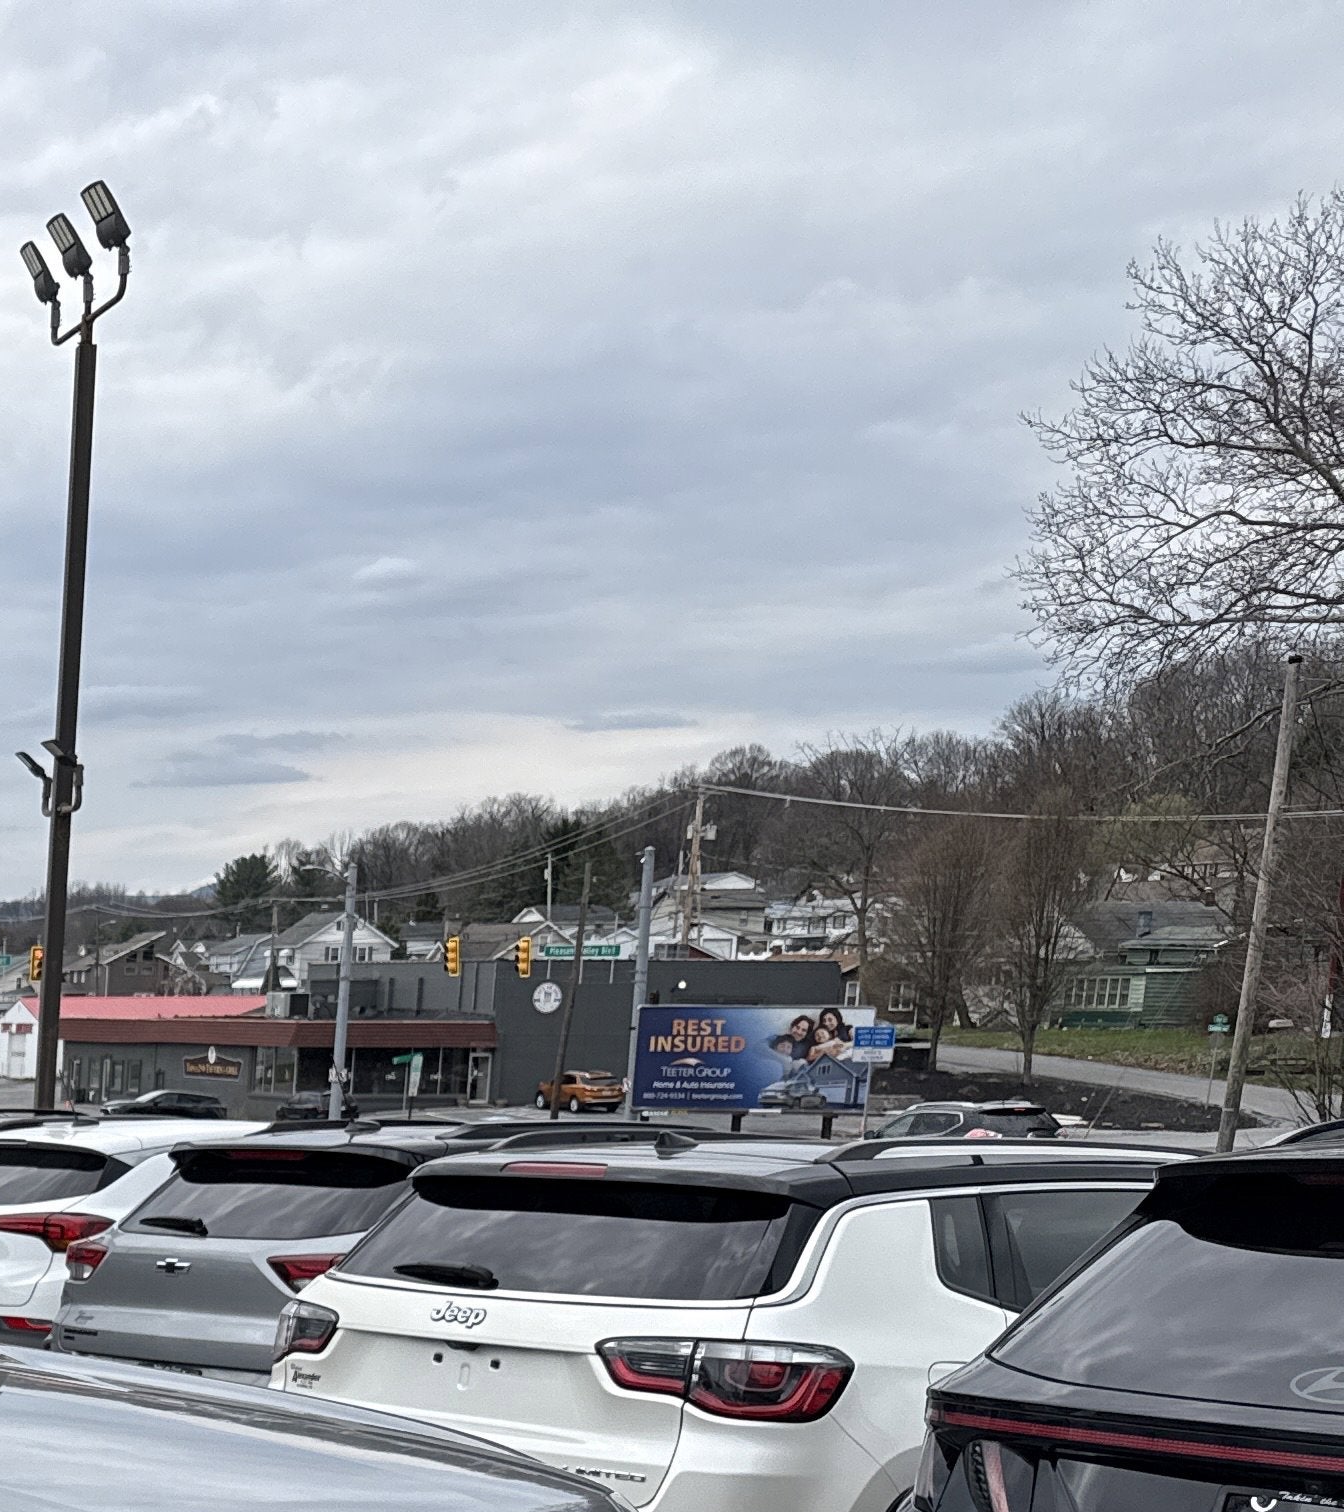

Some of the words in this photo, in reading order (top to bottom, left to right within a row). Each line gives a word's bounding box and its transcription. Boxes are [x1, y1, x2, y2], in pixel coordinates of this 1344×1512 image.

[549, 946, 574, 956] Pleasan
[583, 946, 599, 957] alley
[672, 1019, 727, 1035] REST
[649, 1036, 746, 1052] INSURED
[696, 1066, 731, 1078] GROUP
[652, 1081, 674, 1089] Home
[682, 1081, 699, 1089] Auto
[700, 1081, 735, 1089] Insurance
[430, 1301, 487, 1329] Jeep
[562, 1464, 647, 1483] IMITED
